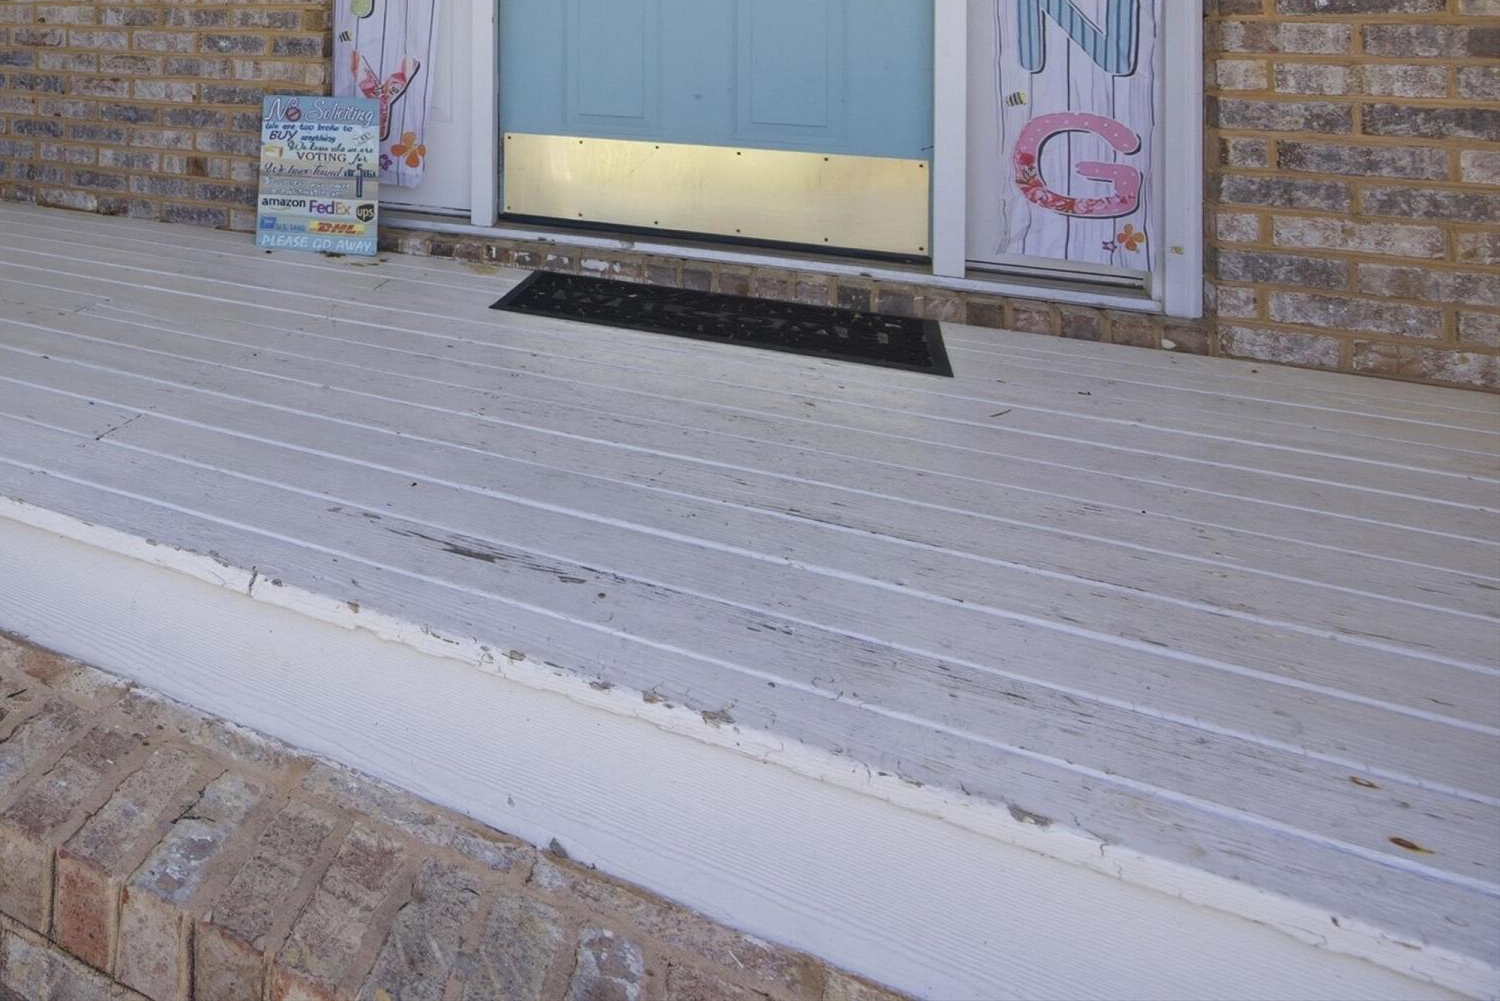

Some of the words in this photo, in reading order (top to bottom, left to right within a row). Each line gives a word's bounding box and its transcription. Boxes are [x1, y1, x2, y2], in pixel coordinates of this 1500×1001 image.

[305, 100, 374, 128] Soliciting
[300, 123, 314, 131] too
[269, 130, 297, 143] BUY
[297, 152, 347, 163] VOTING
[262, 197, 306, 208] amazon
[309, 201, 351, 215] FedEx
[357, 208, 374, 219] ups
[317, 222, 356, 234] DHL
[261, 234, 309, 247] PLEASE
[312, 237, 331, 248] GO
[335, 239, 372, 252] AWAY
